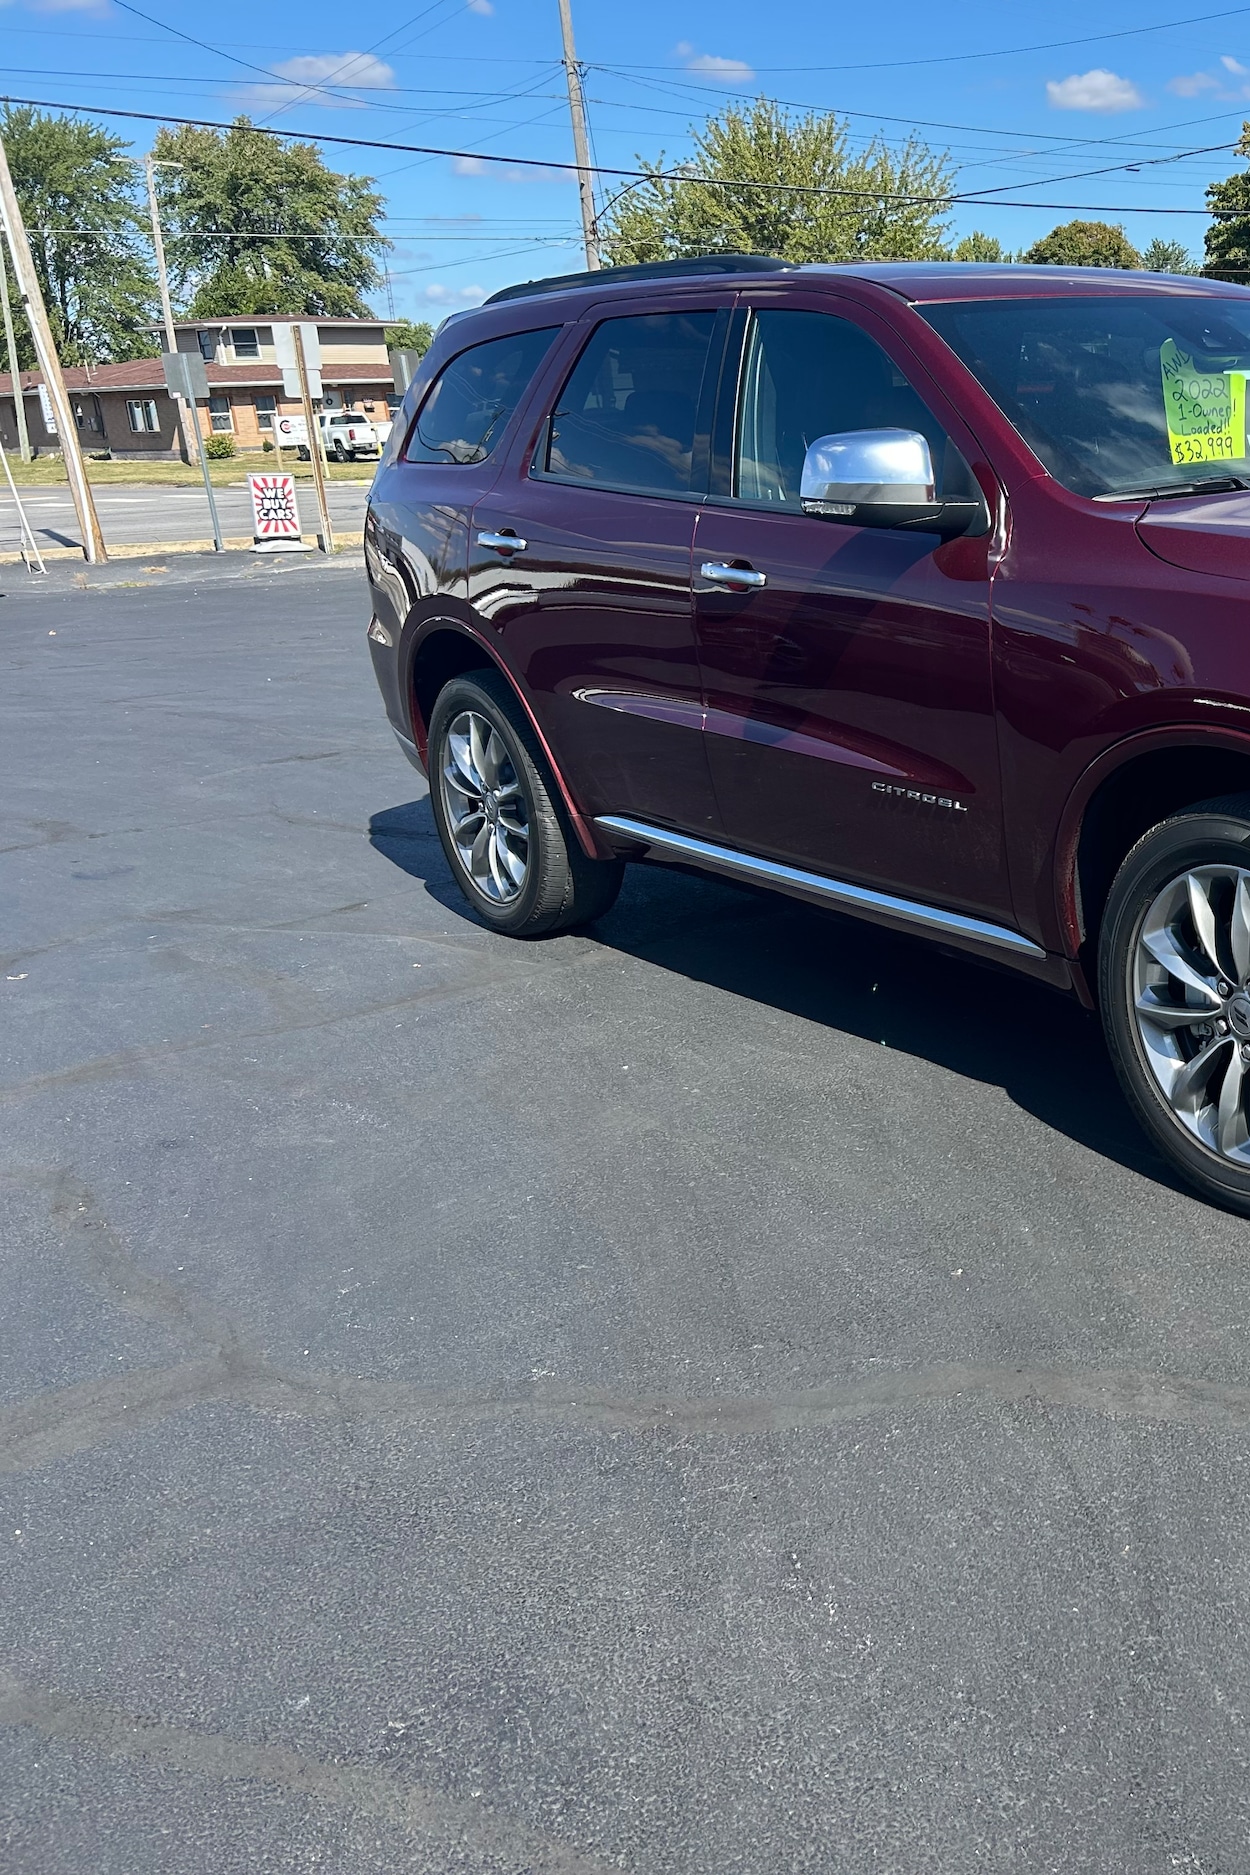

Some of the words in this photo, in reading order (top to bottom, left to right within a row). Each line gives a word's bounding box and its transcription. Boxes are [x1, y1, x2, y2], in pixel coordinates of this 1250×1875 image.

[1172, 378, 1229, 401] 2022
[1181, 416, 1230, 436] Loaded!!
[1174, 436, 1234, 463] $32,999
[261, 487, 285, 499] WE
[261, 498, 288, 509] BUY
[258, 508, 294, 520] CARS
[871, 781, 968, 812] CITADEL
